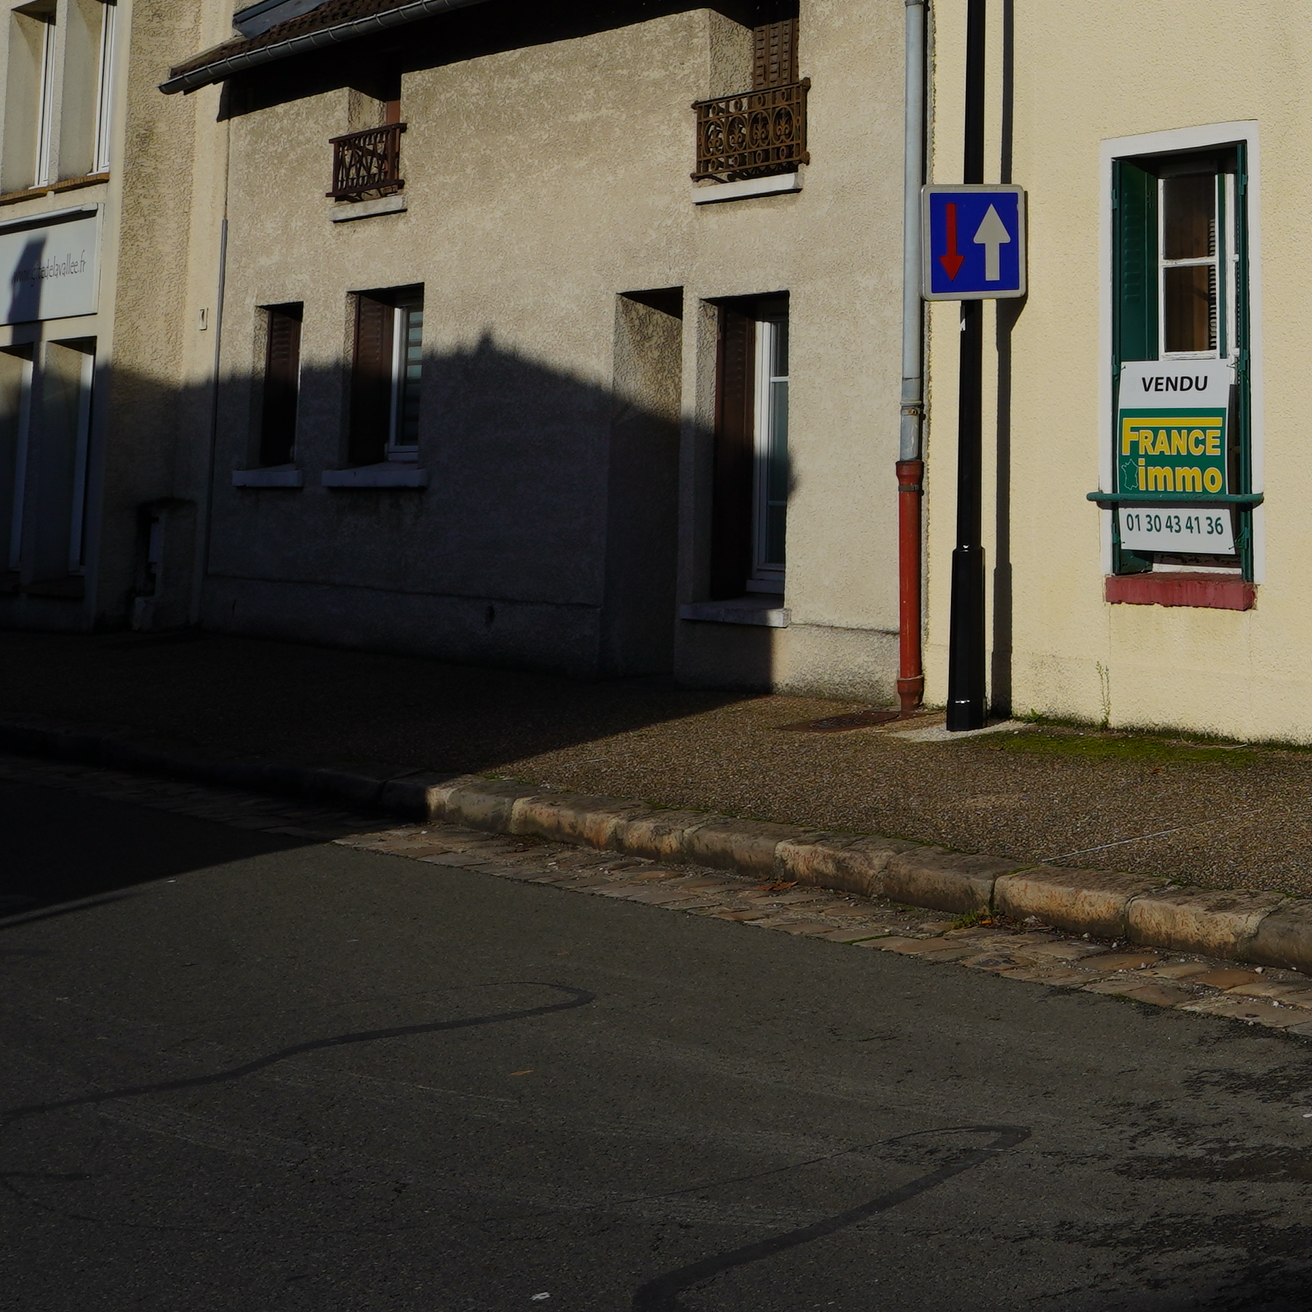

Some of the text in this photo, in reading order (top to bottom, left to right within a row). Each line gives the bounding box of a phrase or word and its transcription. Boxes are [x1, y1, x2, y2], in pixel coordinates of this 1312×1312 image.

[1141, 375, 1209, 392] VENDU
[1121, 416, 1224, 456] FRANCE
[1138, 457, 1223, 493] immo
[1126, 513, 1224, 536] 01 30 43 41 36
